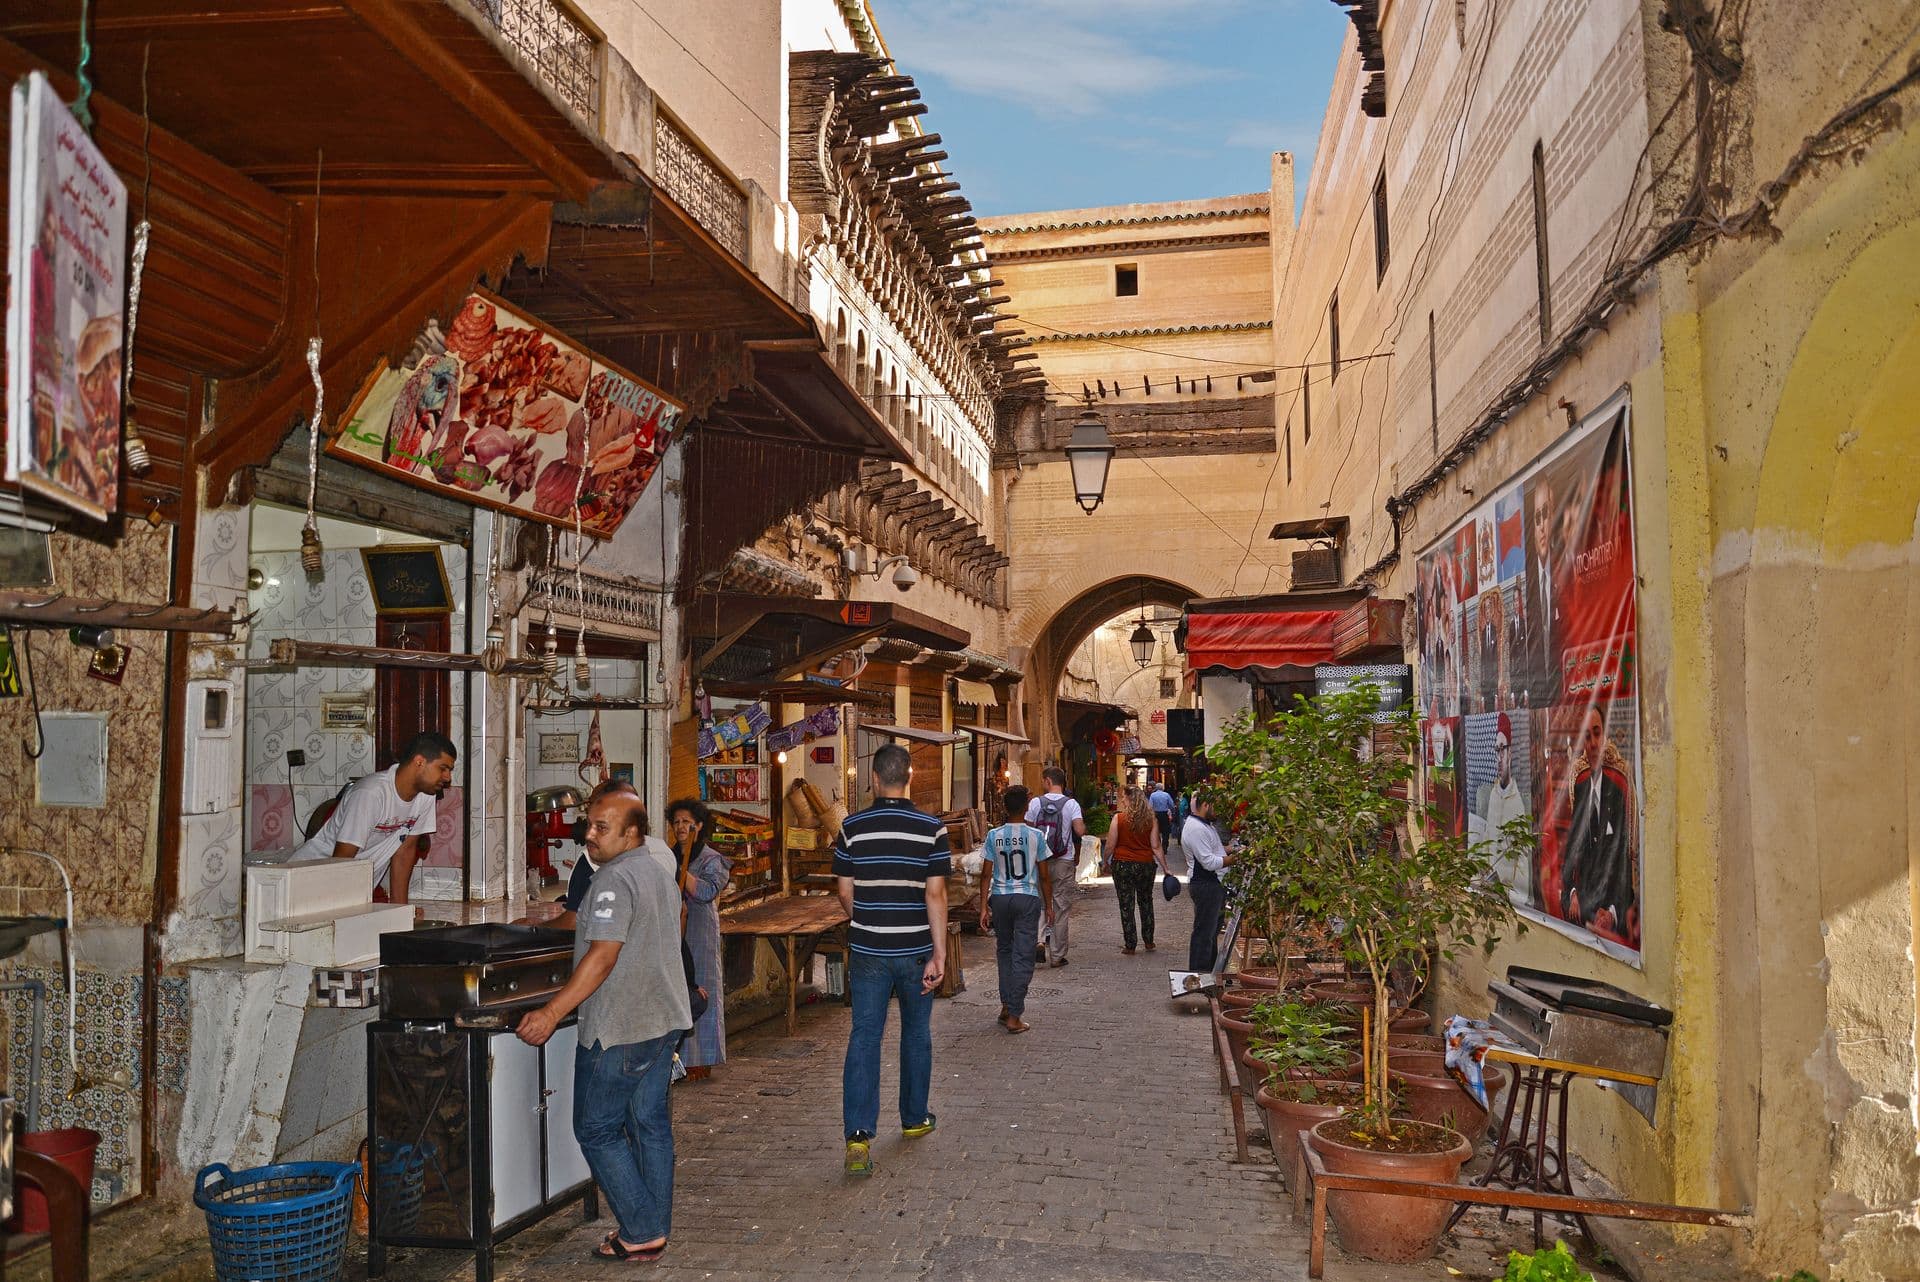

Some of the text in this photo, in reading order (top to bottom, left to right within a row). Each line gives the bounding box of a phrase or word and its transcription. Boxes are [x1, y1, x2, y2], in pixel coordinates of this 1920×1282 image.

[599, 369, 661, 421] TURKEY
[1325, 680, 1346, 688] Chez
[995, 837, 1028, 847] MESSI
[999, 849, 1028, 881] 10
